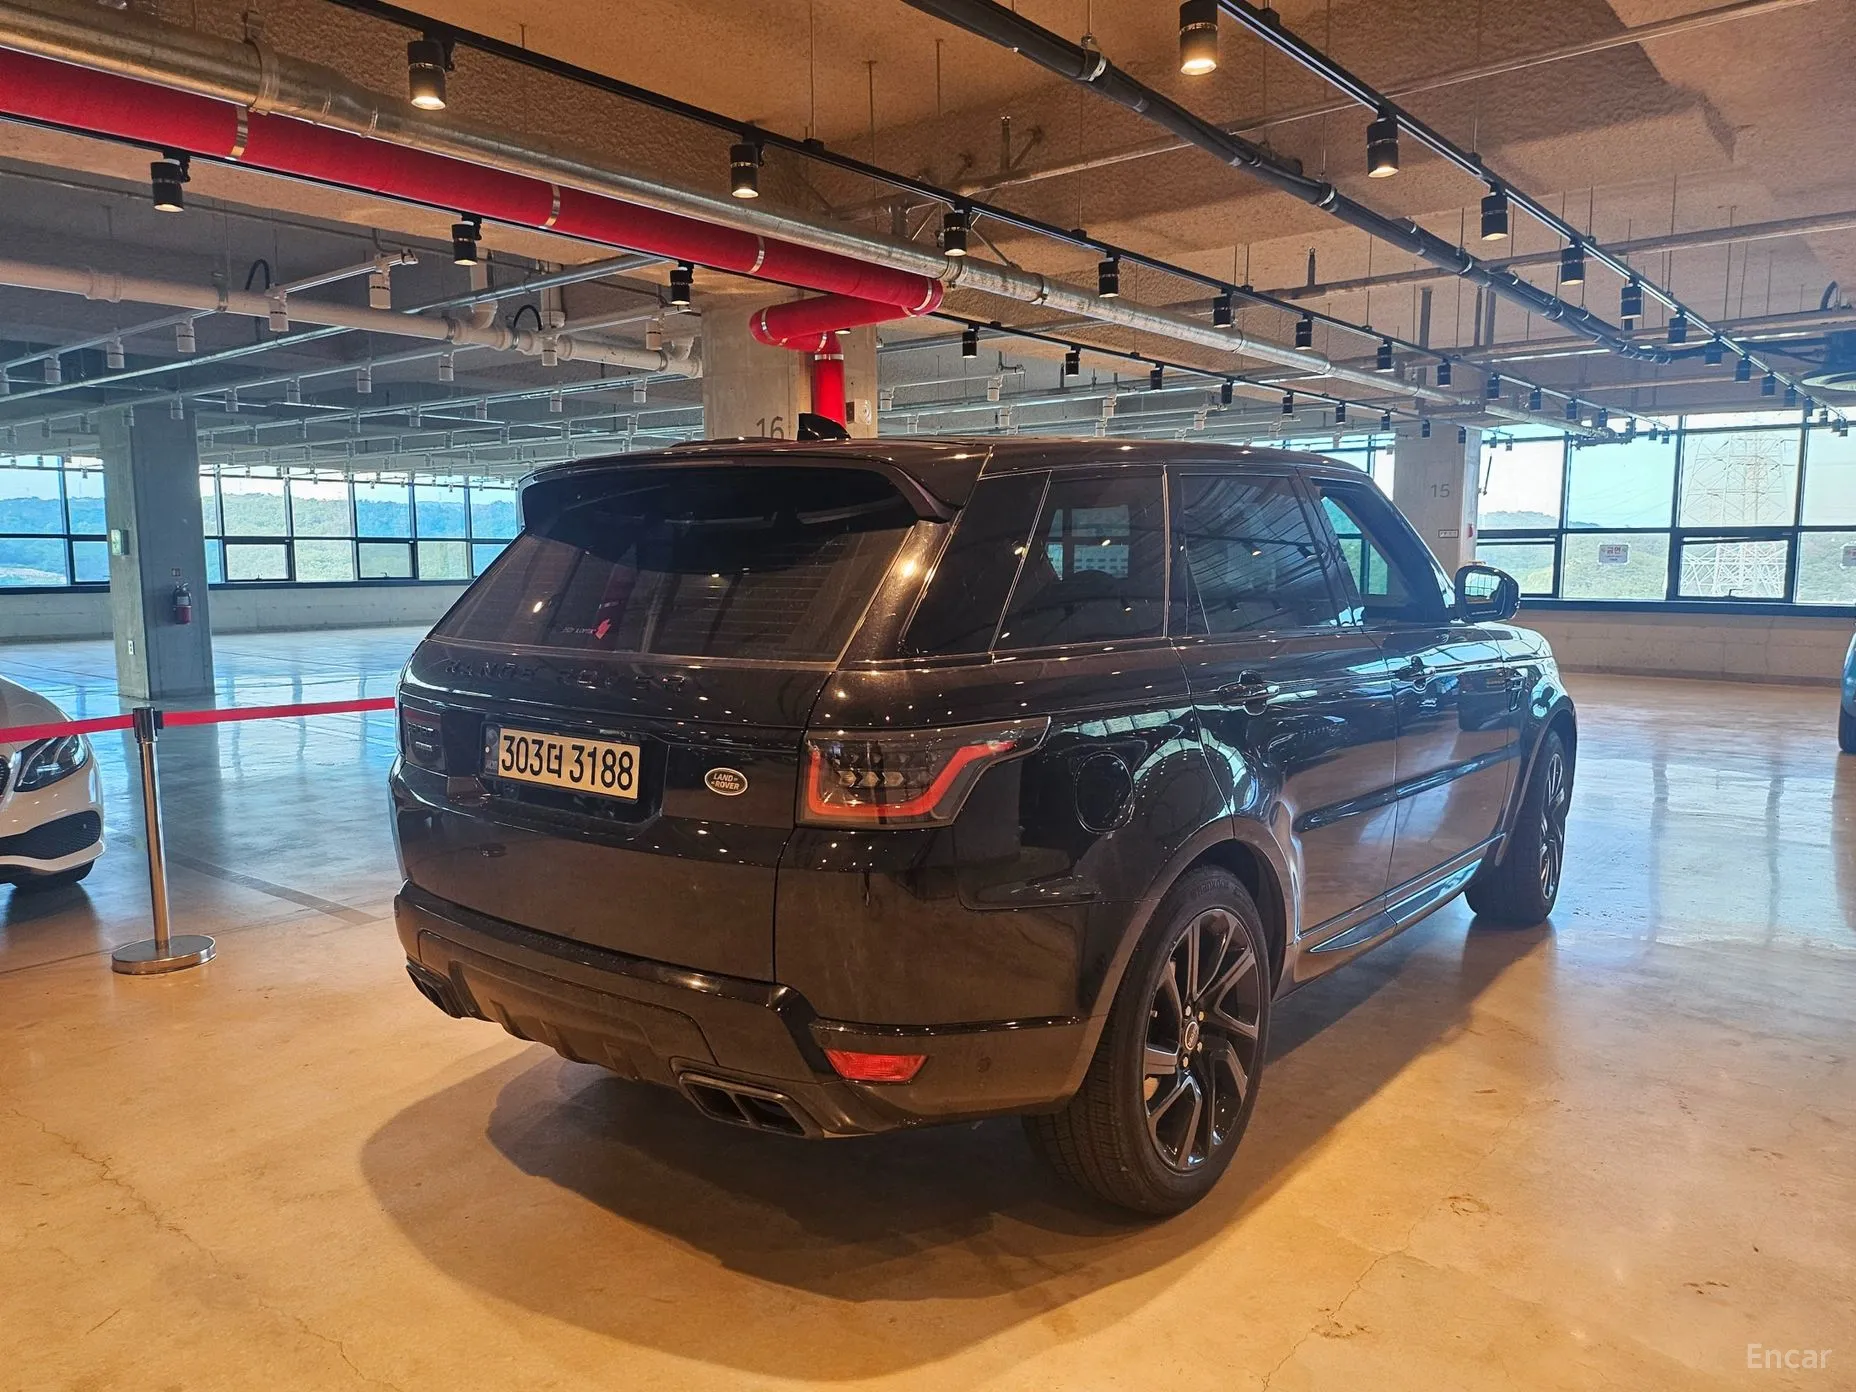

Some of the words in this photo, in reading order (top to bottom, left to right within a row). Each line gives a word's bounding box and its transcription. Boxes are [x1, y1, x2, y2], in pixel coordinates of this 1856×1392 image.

[756, 415, 785, 440] 16
[1430, 483, 1450, 498] 15
[501, 734, 564, 779] 303더
[569, 743, 634, 791] 3188
[713, 773, 734, 782] LAND
[715, 780, 740, 790] ROVER
